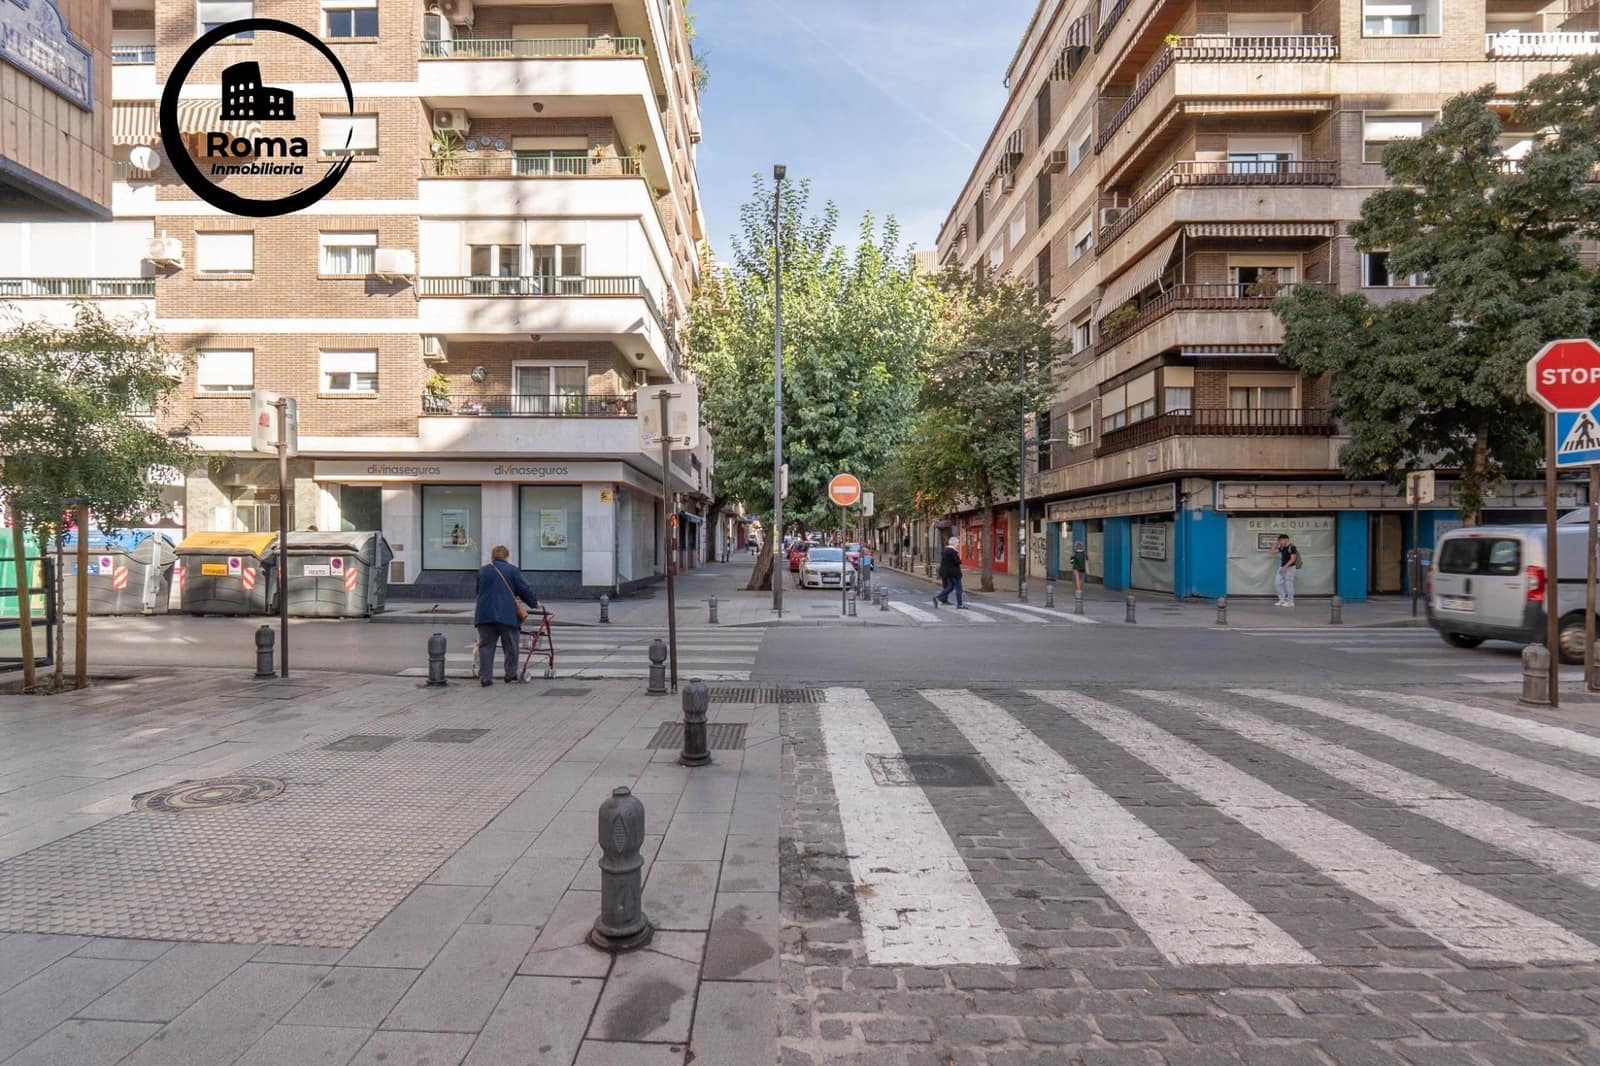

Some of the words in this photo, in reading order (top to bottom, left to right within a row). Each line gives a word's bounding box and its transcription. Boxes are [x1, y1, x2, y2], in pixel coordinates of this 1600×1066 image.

[1541, 367, 1600, 385] STOP
[368, 465, 440, 476] divinaseguros
[494, 465, 568, 477] divinaseguros
